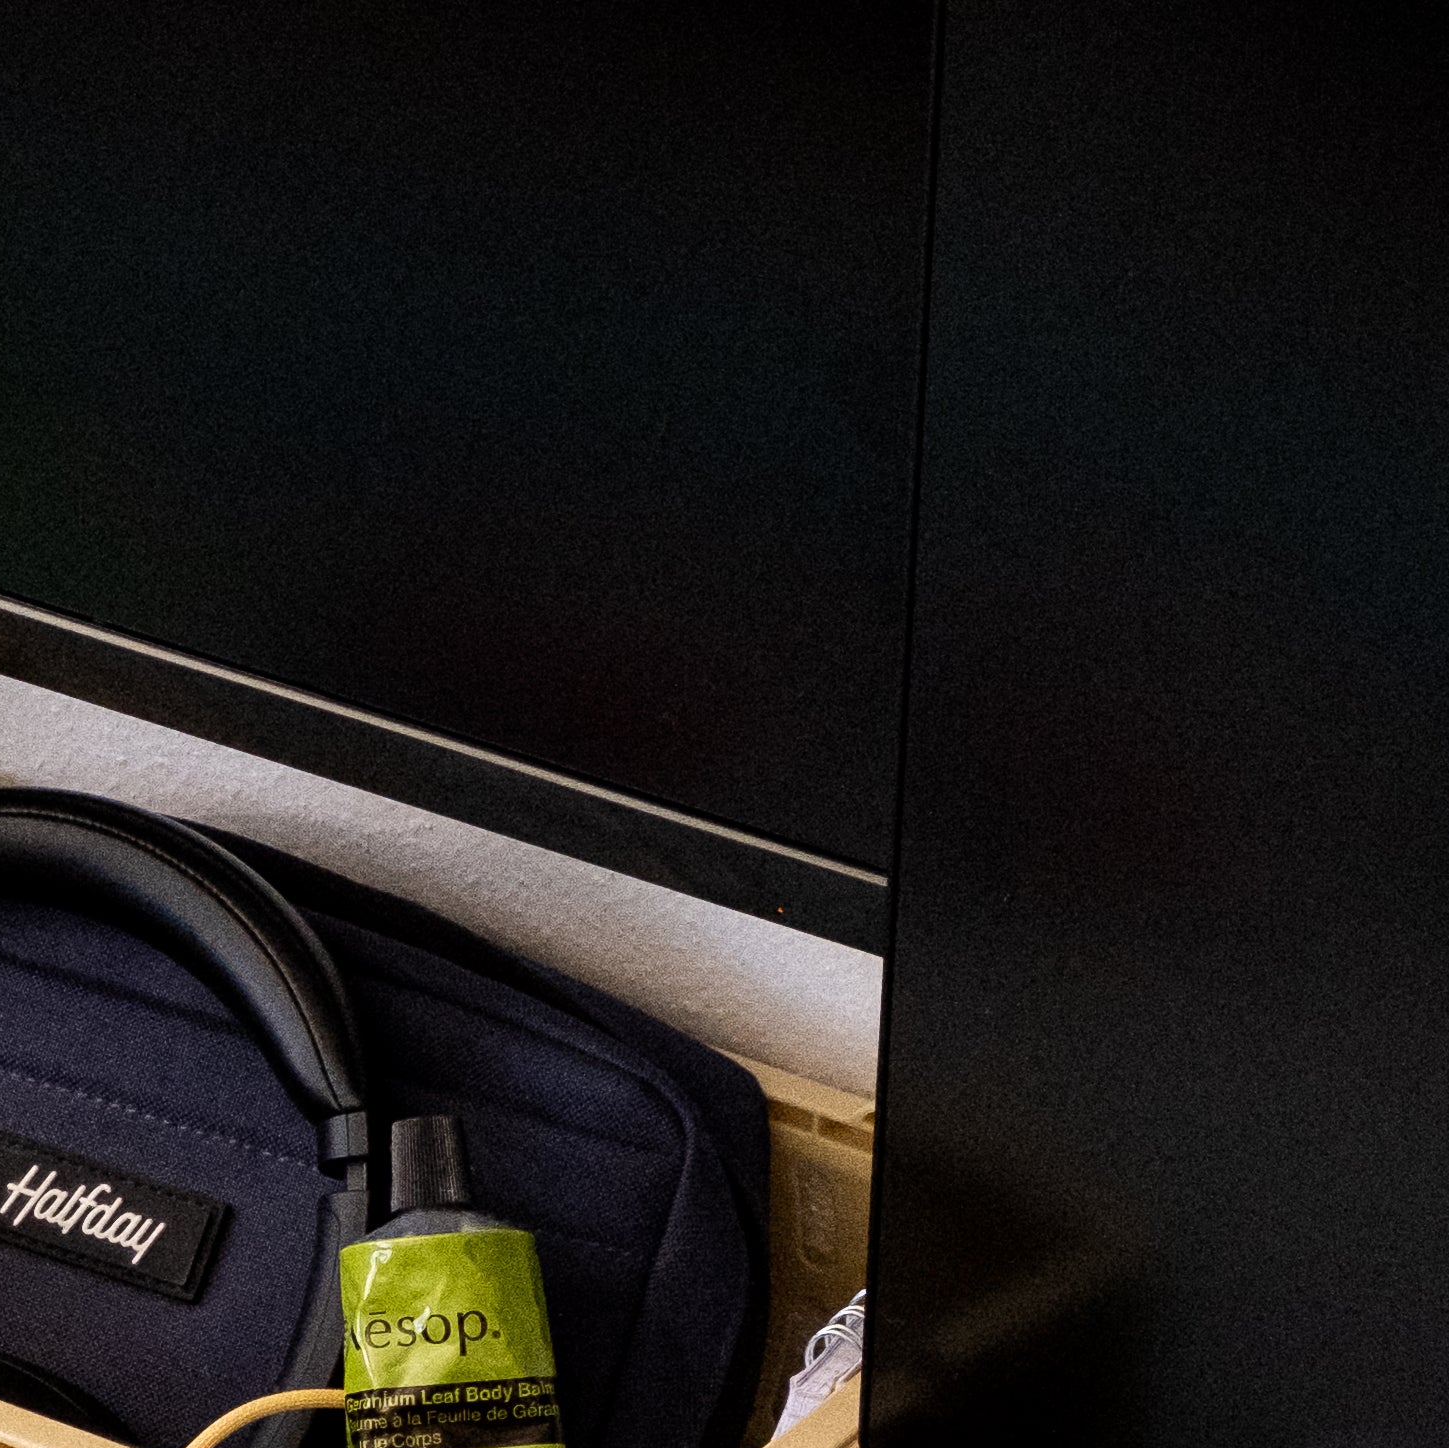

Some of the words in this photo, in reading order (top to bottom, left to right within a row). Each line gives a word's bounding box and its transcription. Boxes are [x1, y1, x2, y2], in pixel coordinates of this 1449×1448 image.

[0, 1164, 166, 1265] Halfday
[421, 1388, 460, 1405] Leaf
[466, 1384, 513, 1403] Body
[392, 1412, 402, 1428] à
[407, 1411, 421, 1425] la
[427, 1408, 482, 1424] Feuille
[486, 1406, 508, 1420] de
[513, 1401, 560, 1419] Géran
[392, 1432, 443, 1448] Corps
